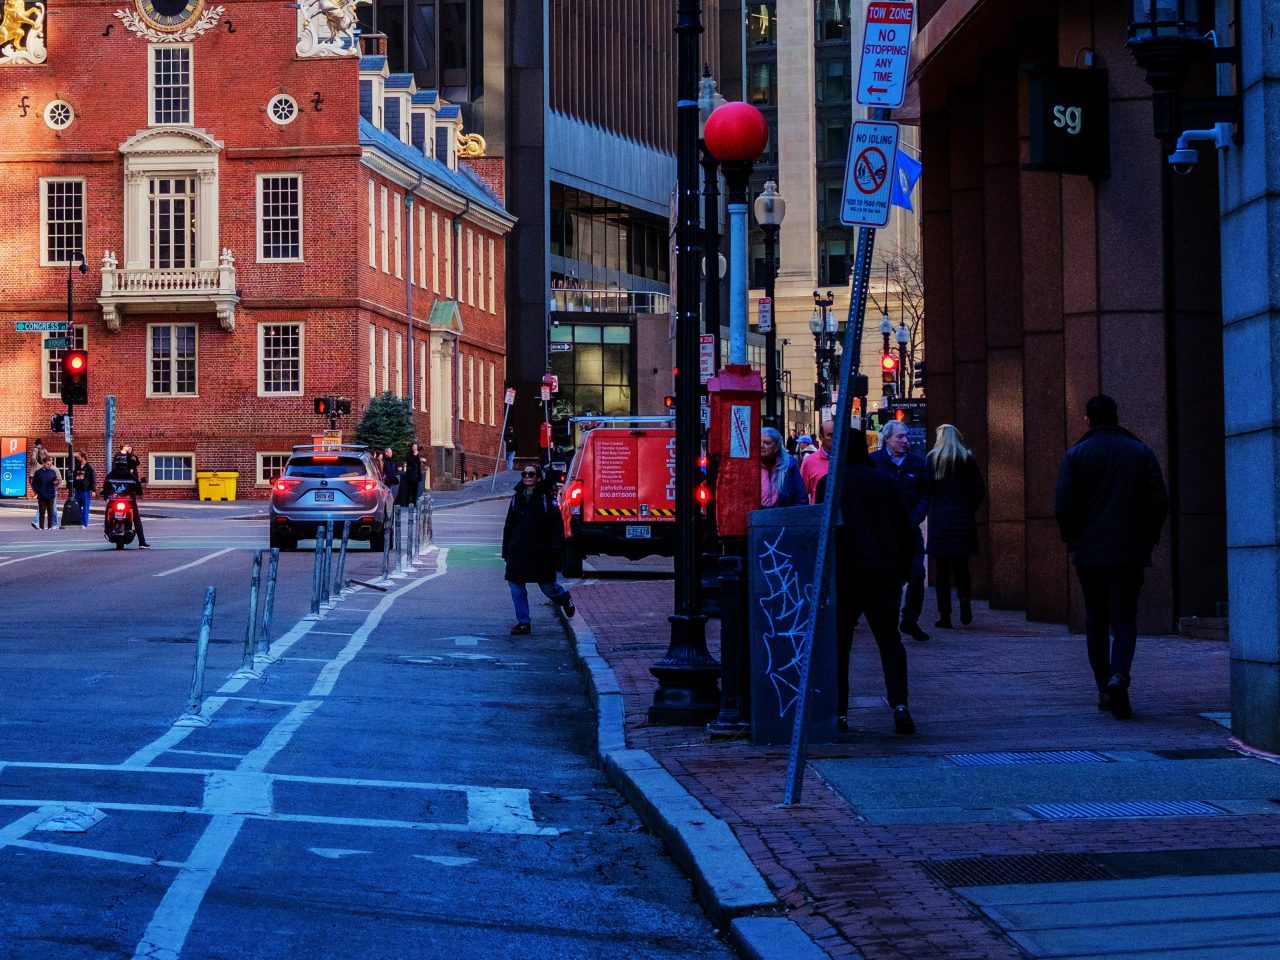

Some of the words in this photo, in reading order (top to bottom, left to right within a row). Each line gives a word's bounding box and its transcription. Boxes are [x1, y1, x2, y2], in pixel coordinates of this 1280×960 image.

[870, 7, 886, 19] TOW
[890, 8, 912, 20] ZONE
[878, 29, 896, 42] NO
[864, 44, 907, 56] STOPPING
[875, 58, 892, 68] ANY
[873, 72, 892, 82] TIME
[1054, 105, 1082, 134] sg
[856, 134, 866, 143] NO
[868, 134, 892, 144] IDLING
